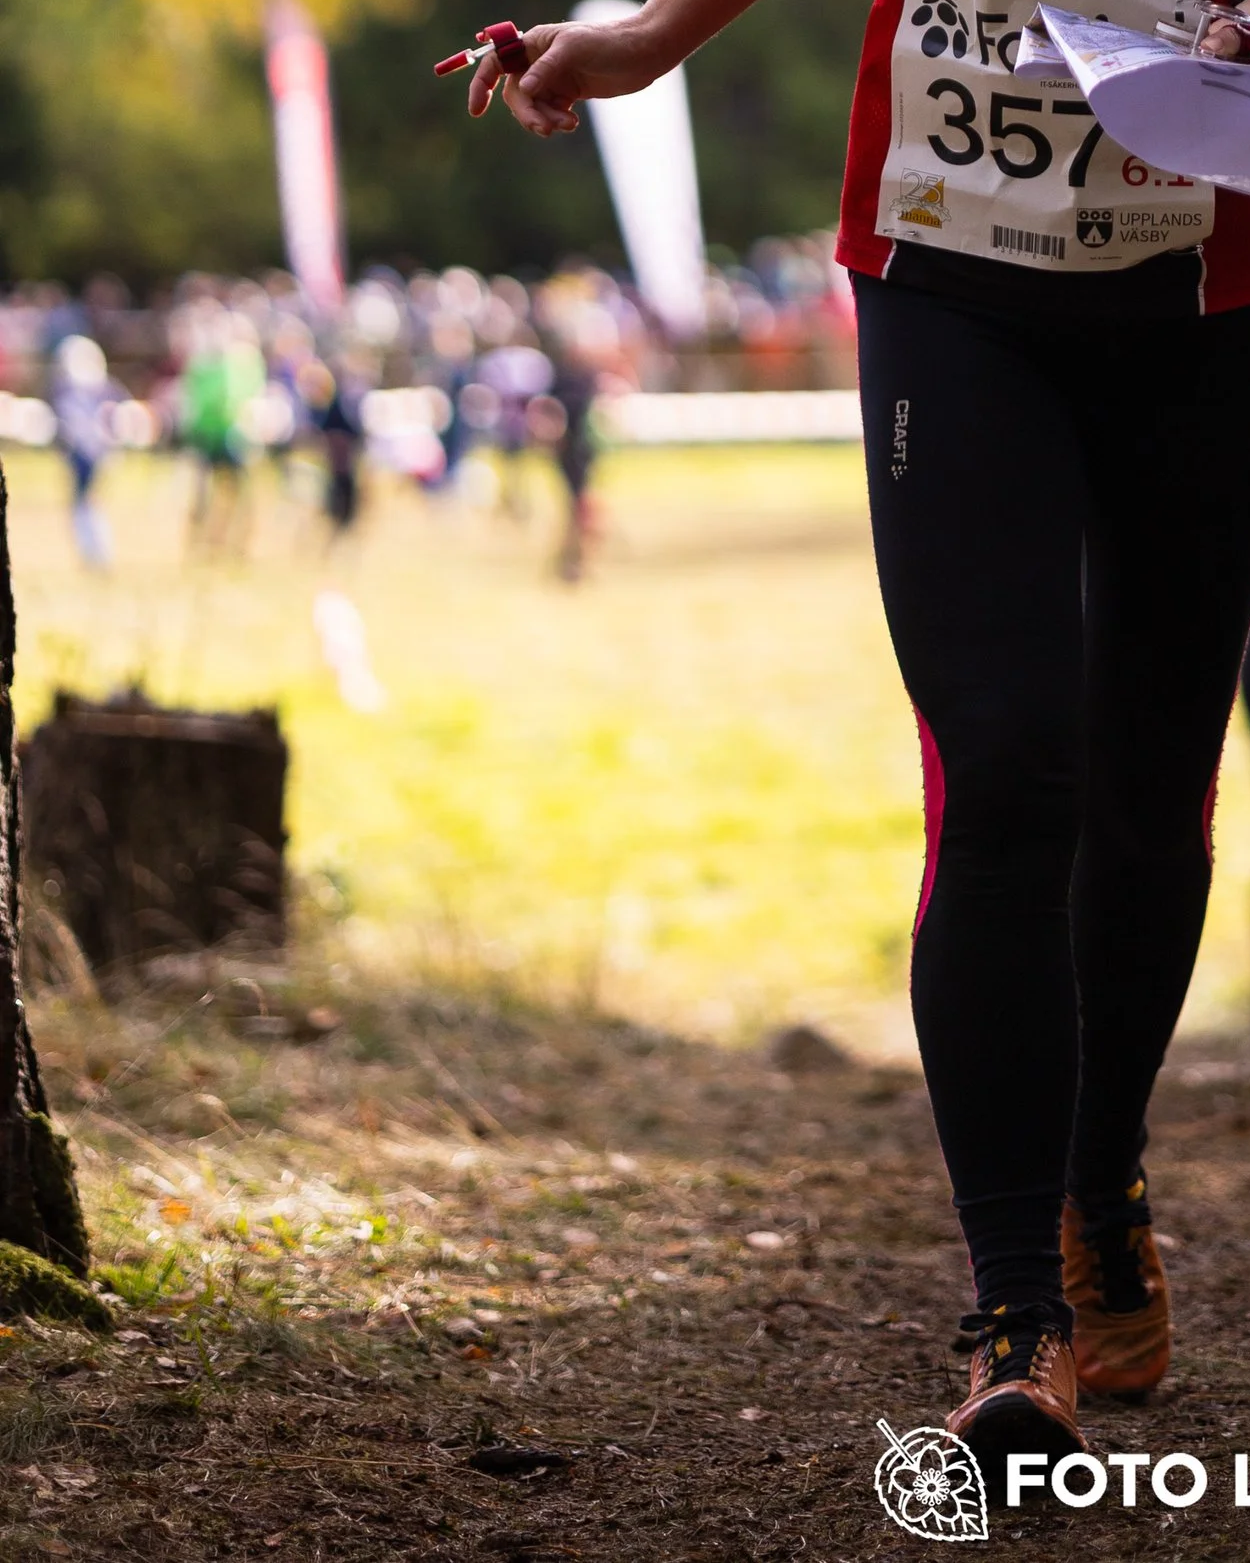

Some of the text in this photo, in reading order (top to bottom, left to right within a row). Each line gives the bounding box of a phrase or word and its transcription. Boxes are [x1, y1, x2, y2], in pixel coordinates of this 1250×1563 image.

[1040, 80, 1079, 89] IT-SÄKERH
[926, 78, 1102, 187] 357
[904, 171, 941, 204] 25
[1120, 213, 1203, 227] UPPLANDS
[1120, 227, 1170, 242] VÄSBY
[894, 399, 909, 462] CRAFT
